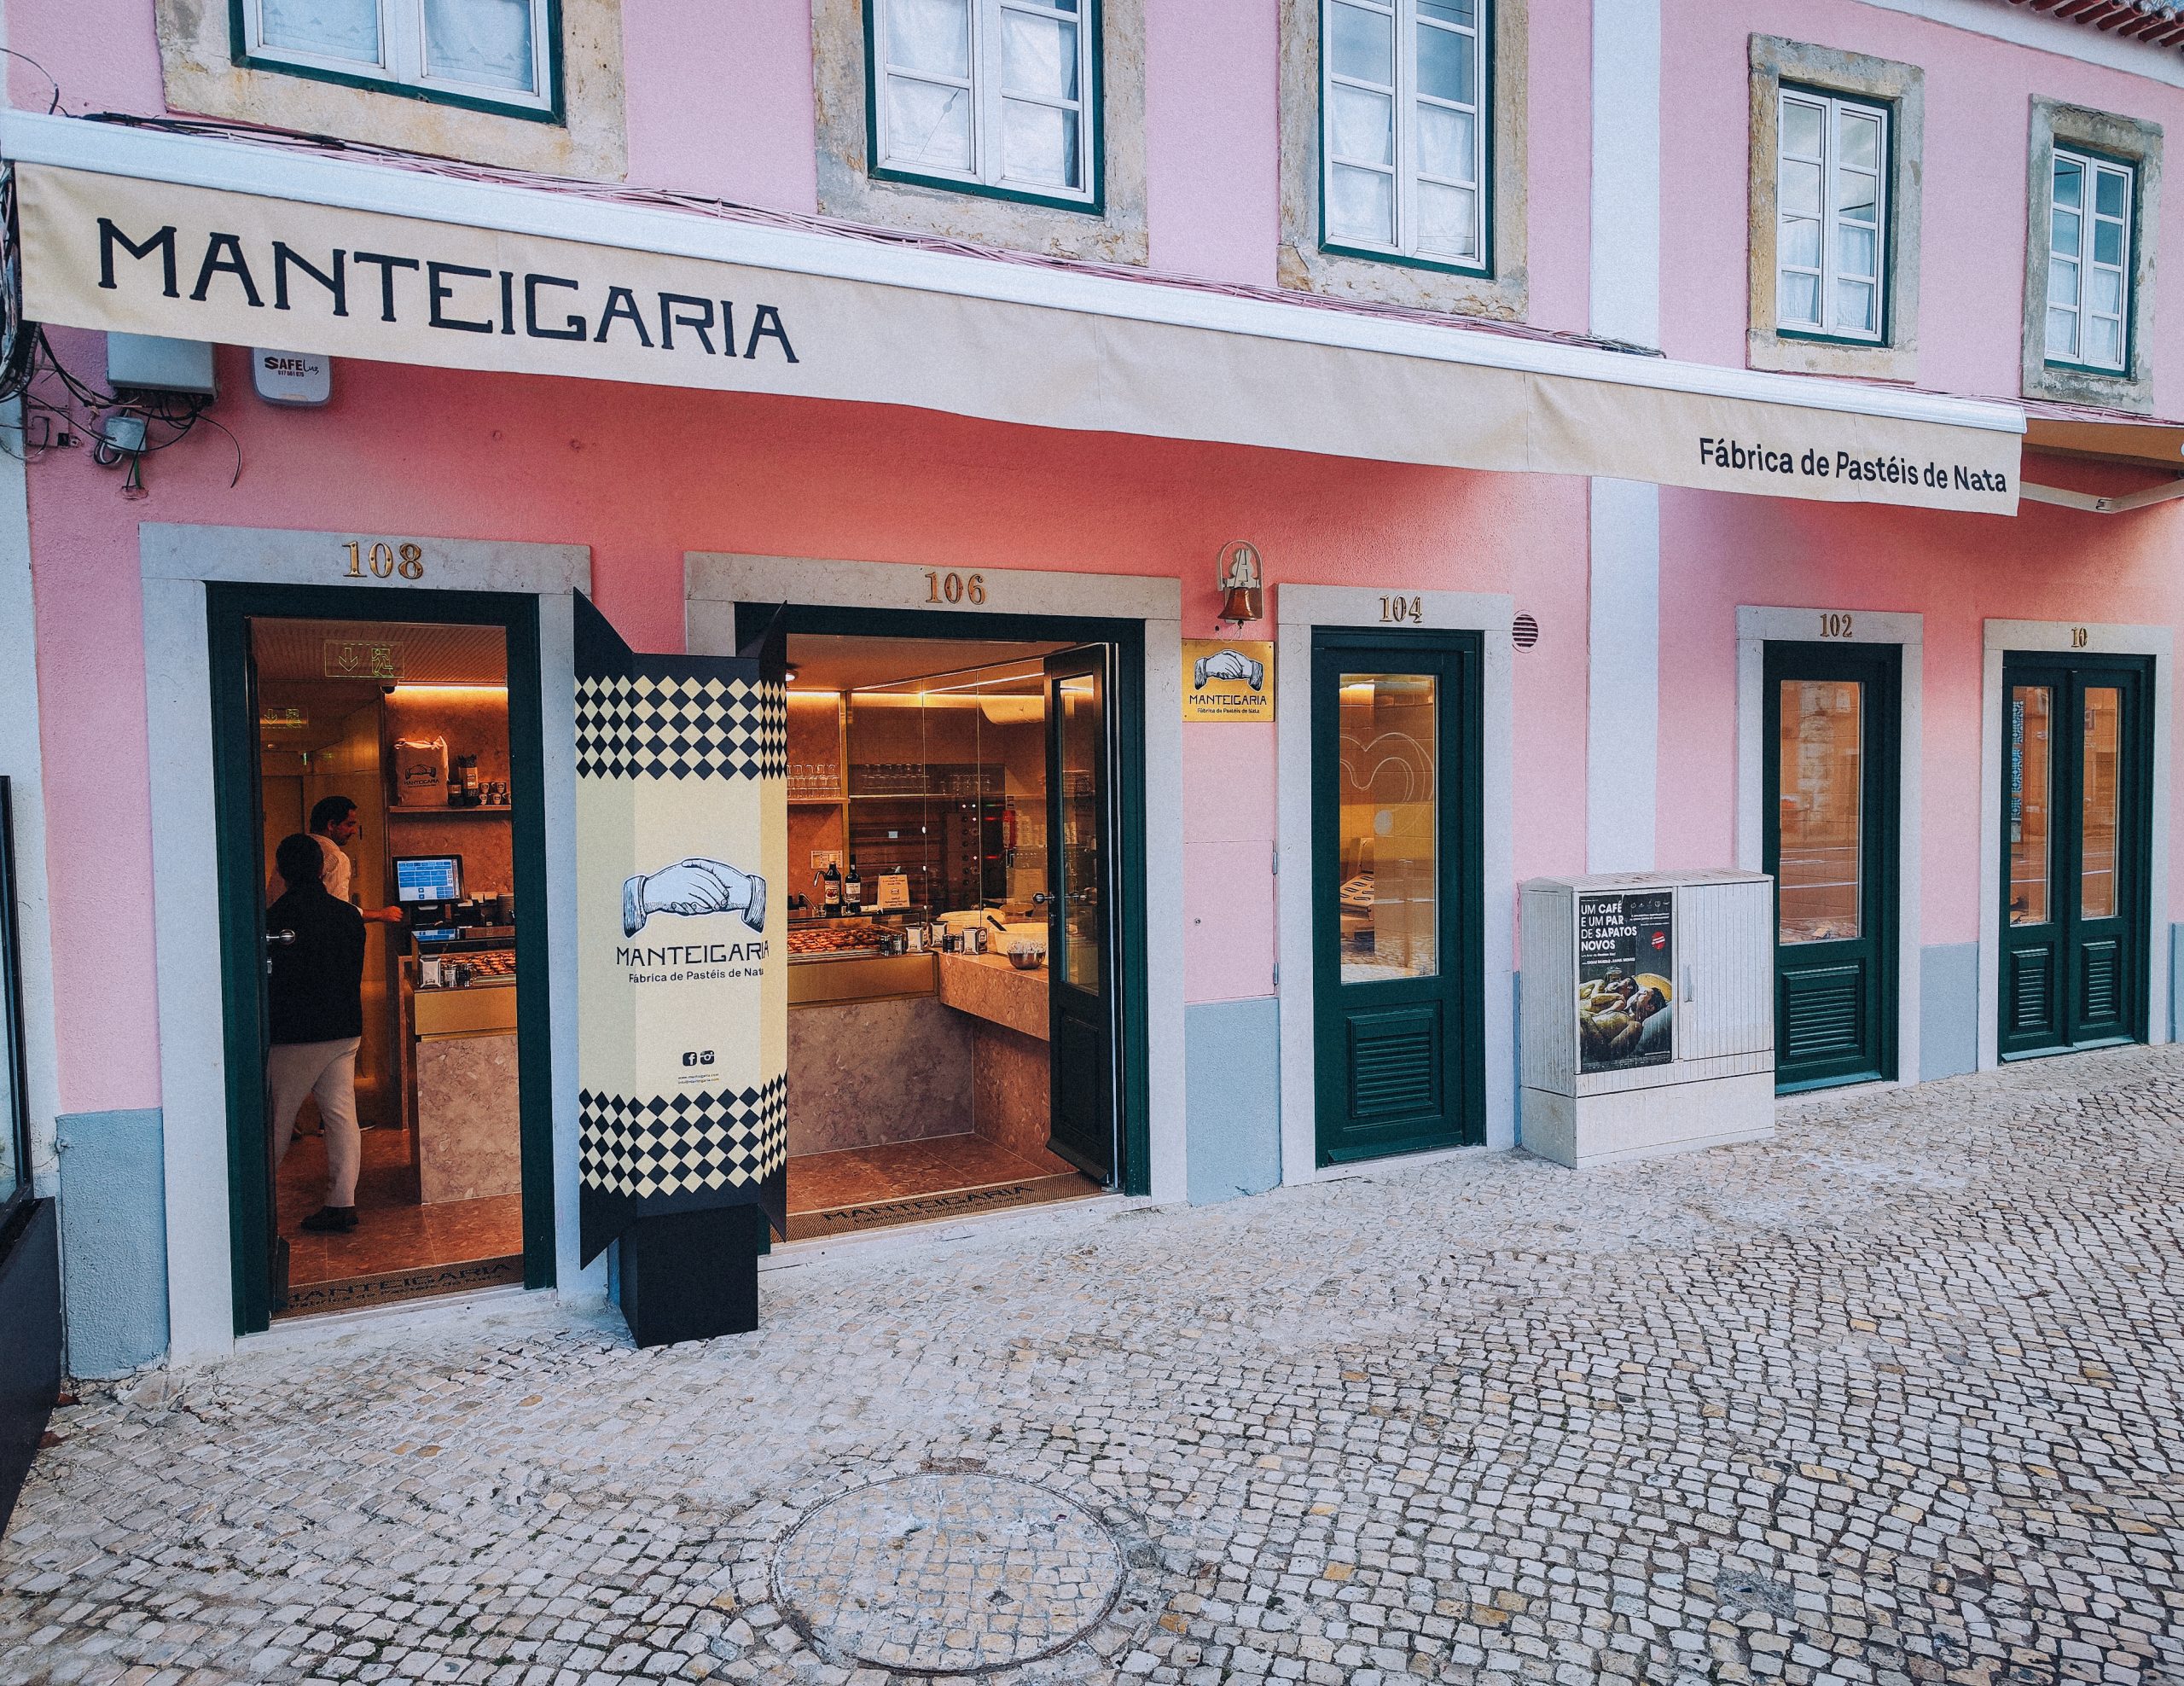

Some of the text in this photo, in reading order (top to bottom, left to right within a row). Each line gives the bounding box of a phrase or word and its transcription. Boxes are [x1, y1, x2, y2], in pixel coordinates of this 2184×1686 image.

[97, 217, 799, 364] MANTEIGARIA
[1699, 437, 2007, 492] Fábrica de Pastéis de Nata
[342, 541, 423, 579] 108
[925, 572, 985, 605] 106
[1379, 594, 1422, 623] 104
[1820, 613, 1852, 637] 102
[2071, 626, 2088, 648] 10
[1189, 695, 1267, 706] MANTEIGARIA
[1581, 900, 1623, 915] UM CAFÉ
[1581, 917, 1587, 927] E
[1589, 916, 1604, 927] UM
[1606, 916, 1624, 926] PAR
[1581, 927, 1637, 939] DE SAPATOS
[617, 940, 769, 967] MANTEIGARIA
[1581, 939, 1616, 951] NOVOS
[629, 973, 667, 983] Fábrica
[671, 972, 682, 980] de
[687, 970, 725, 980] Pastéis
[729, 968, 741, 978] de
